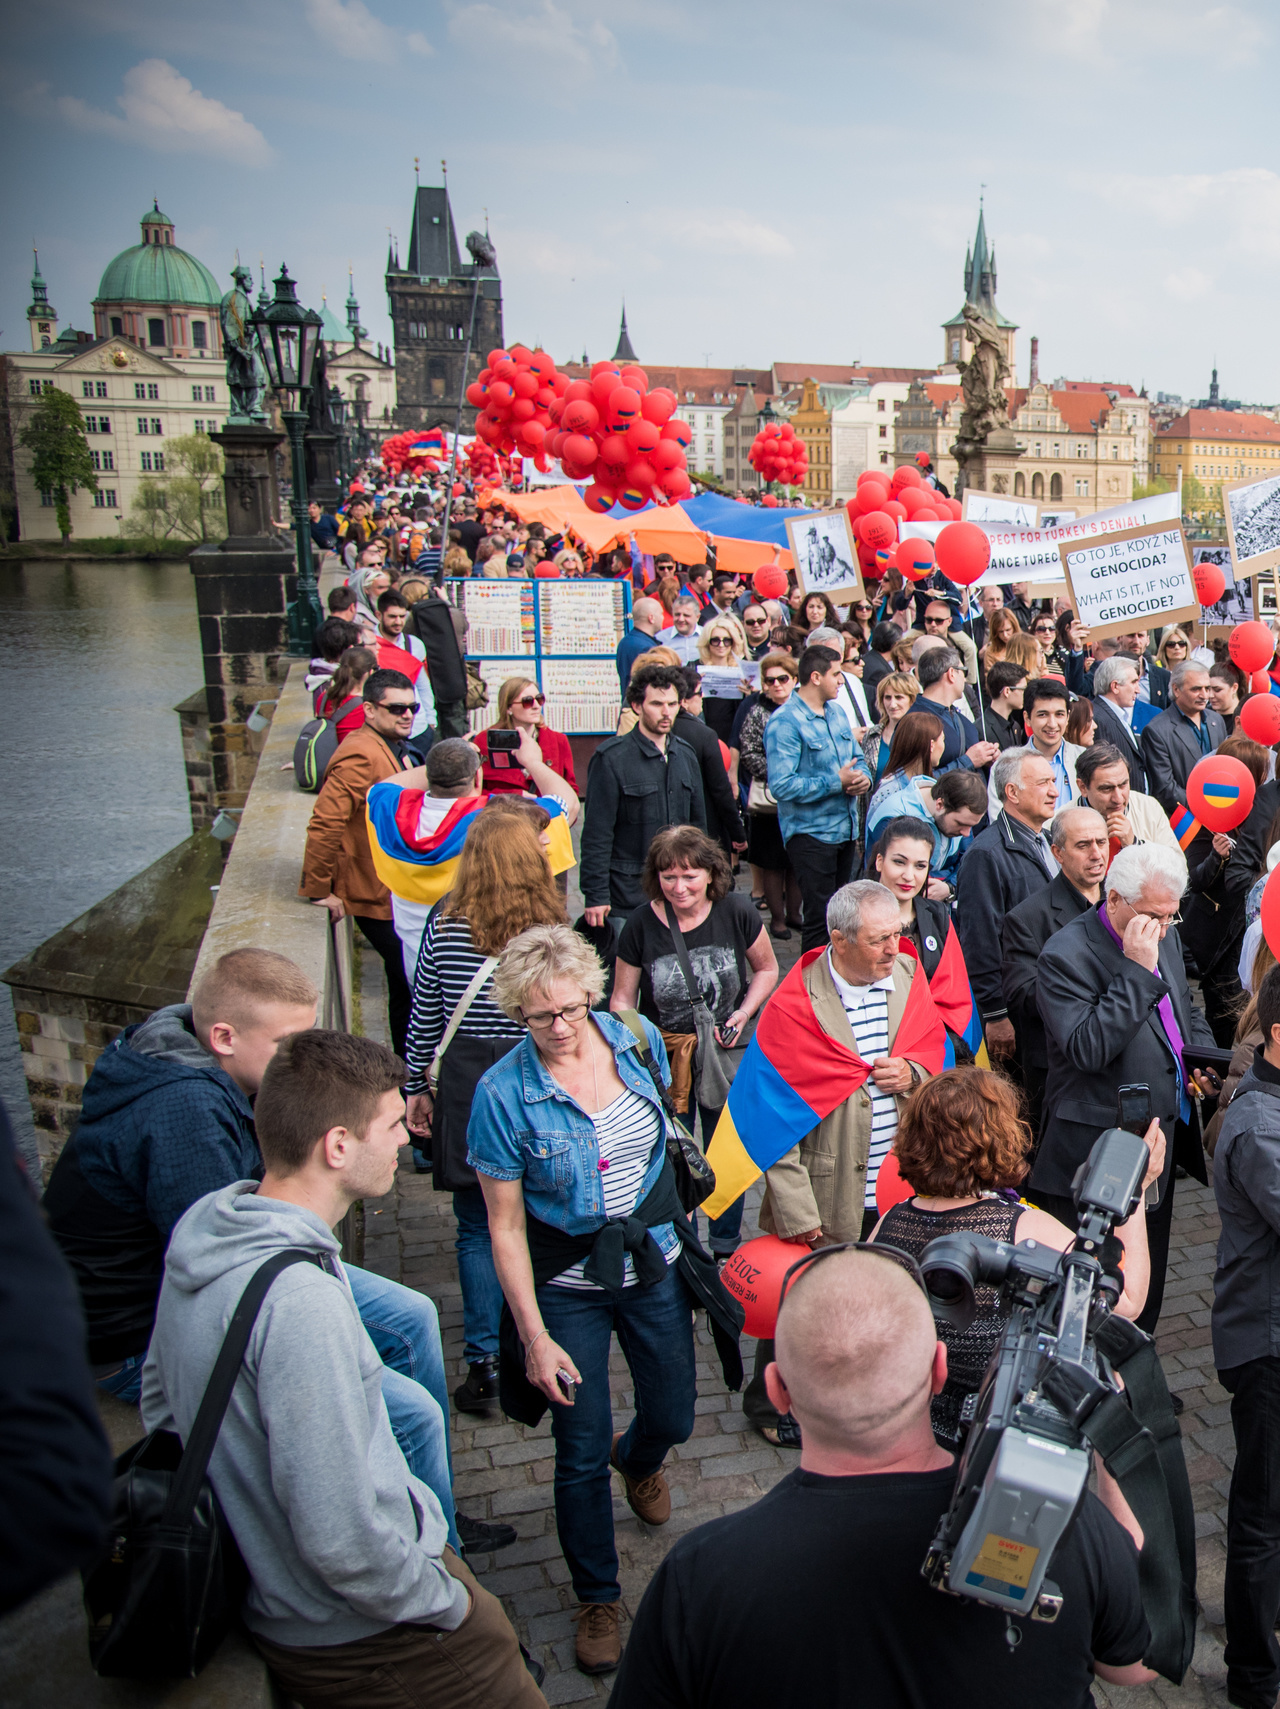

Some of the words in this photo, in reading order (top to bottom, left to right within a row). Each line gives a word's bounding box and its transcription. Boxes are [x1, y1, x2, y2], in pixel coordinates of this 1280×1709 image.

[868, 525, 884, 537] 1915
[872, 537, 889, 547] 2015
[989, 533, 1017, 546] PECT
[1020, 531, 1042, 543] FOR
[1045, 522, 1098, 541] TURKEY'S
[1101, 516, 1141, 532] DENIAL
[1067, 552, 1086, 566] CO
[1087, 548, 1106, 561] TO
[1109, 544, 1125, 558] JE,
[1126, 533, 1161, 554] KDYŽ
[1163, 531, 1181, 545] NE
[987, 556, 1020, 570] ANCE
[1023, 552, 1061, 567] TUREC
[1090, 553, 1167, 579] GENOCIDA?
[1075, 589, 1113, 607] WHAT
[1116, 586, 1128, 599] IS
[1130, 583, 1144, 596] IT,
[1146, 580, 1157, 592] IF
[1159, 573, 1186, 590] NOT
[1099, 594, 1174, 620] GENOCIDE?
[1231, 633, 1240, 642] 15
[1230, 651, 1238, 659] 15
[729, 1254, 761, 1285] 2015
[744, 1289, 758, 1304] WE
